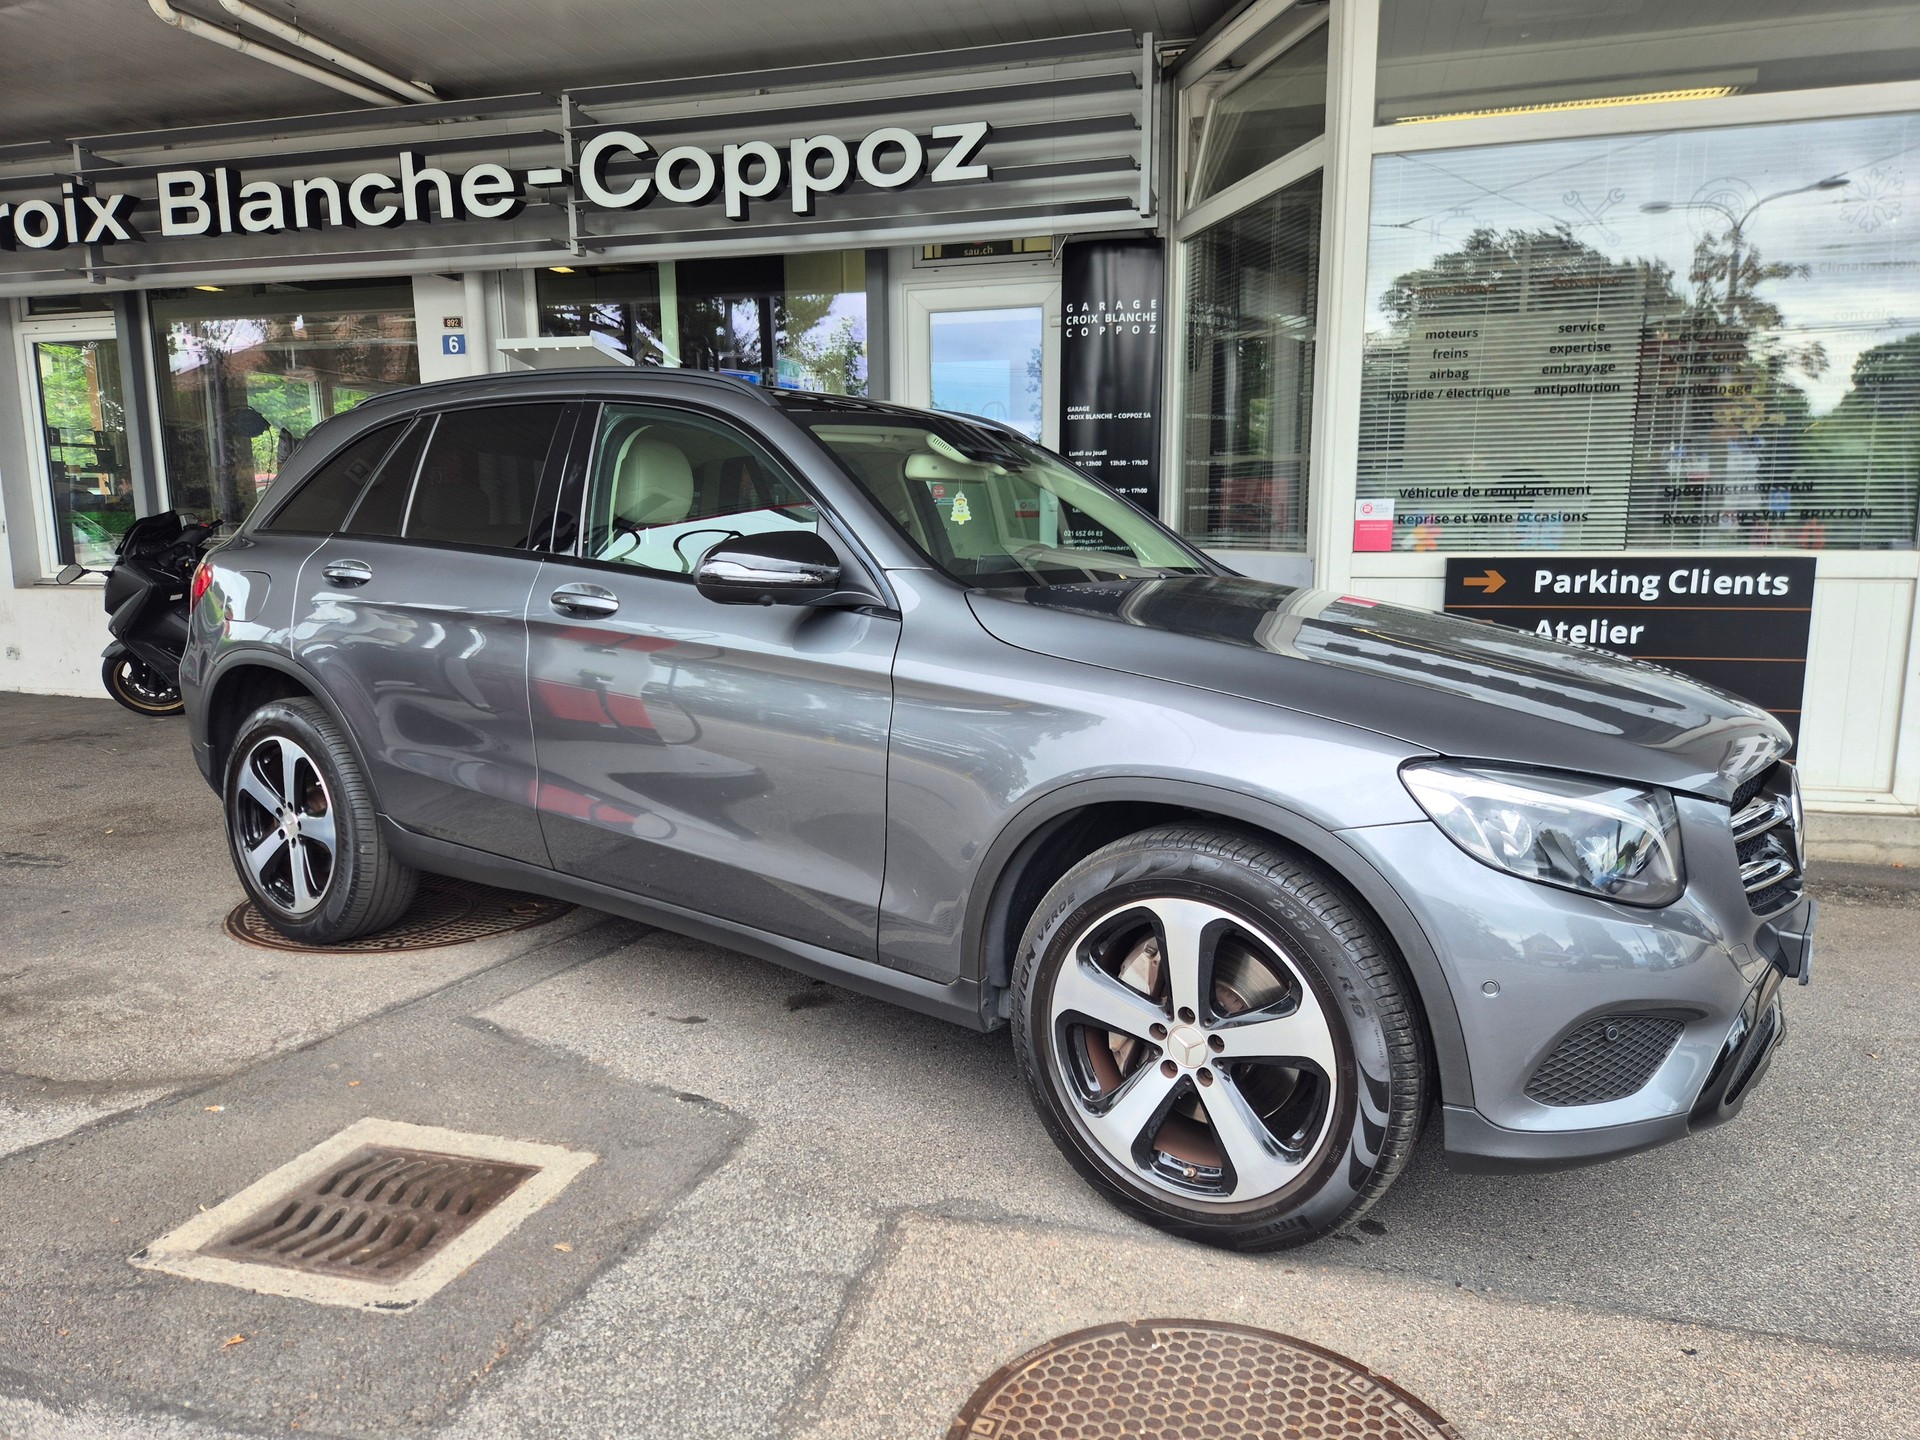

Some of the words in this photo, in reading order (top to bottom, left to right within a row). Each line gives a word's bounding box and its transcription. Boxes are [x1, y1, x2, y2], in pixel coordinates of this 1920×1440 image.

[963, 245, 994, 256] sau.ch
[1818, 259, 1916, 273] Climatisation
[1066, 299, 1157, 313] GARAGE
[446, 318, 459, 327] 892
[1066, 314, 1098, 325] CROIX
[1105, 312, 1157, 323] BLANCHE
[1066, 325, 1156, 337] COPPOZ
[1558, 321, 1606, 333] service
[1425, 329, 1479, 341] moteurs
[448, 336, 459, 353] 6
[1549, 342, 1612, 356] expertise
[1432, 349, 1469, 360] freins
[1429, 368, 1470, 381] airbag
[1541, 362, 1616, 377] embrayage
[1387, 387, 1434, 403] hybride
[1446, 386, 1511, 401] électrique
[1534, 382, 1621, 396] antipollution
[1067, 405, 1090, 413] GARAGE
[1399, 487, 1458, 499] Véhicule
[1463, 487, 1480, 498] de
[1484, 485, 1592, 500] remplacement
[1397, 514, 1450, 527] Reprise
[1453, 513, 1468, 524] et
[1473, 513, 1513, 524] vente
[1517, 511, 1589, 524] occasions
[1799, 508, 1873, 520] BRIXTON
[1534, 568, 1661, 601] Parking
[1667, 568, 1789, 596] Clients
[1534, 619, 1645, 645] Atelier
[1037, 891, 1076, 941] VERDE
